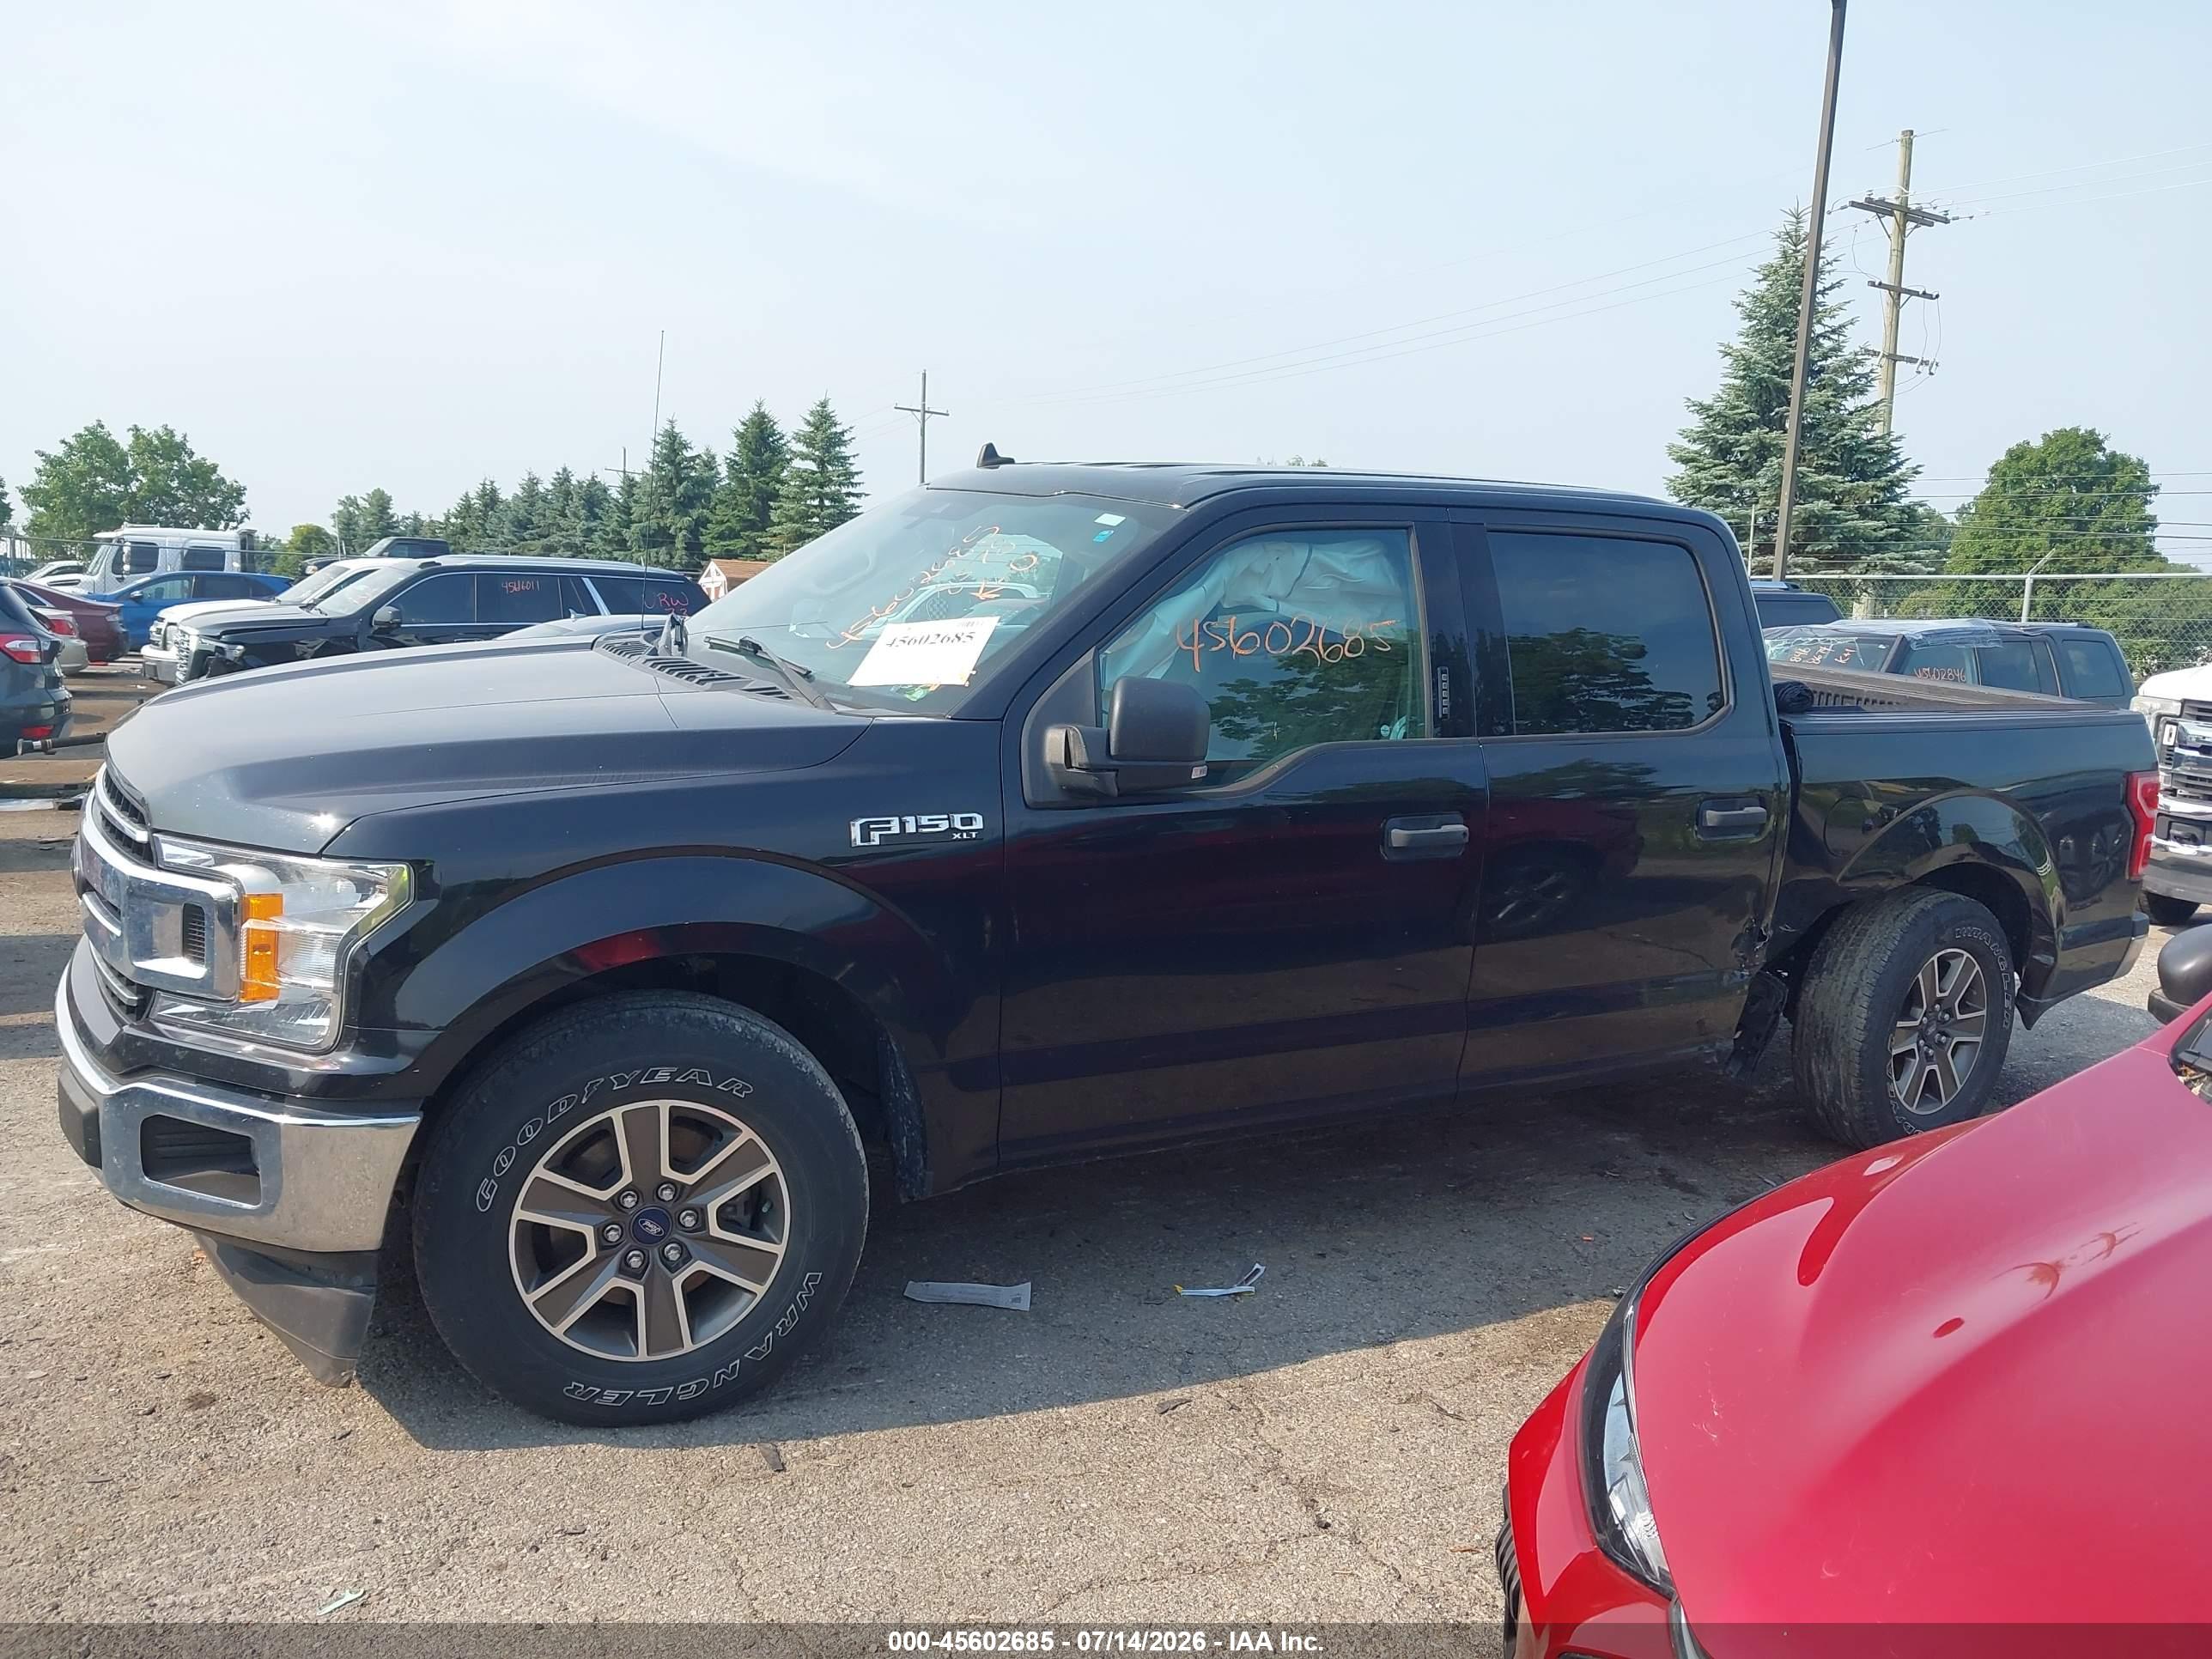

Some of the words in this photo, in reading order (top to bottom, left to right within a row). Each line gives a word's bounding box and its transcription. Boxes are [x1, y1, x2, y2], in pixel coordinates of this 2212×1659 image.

[885, 631, 976, 647] 45602685
[1176, 615, 1401, 673] 45602685
[951, 831, 980, 840] XLT
[475, 1066, 756, 1212] GOODYEAR
[562, 1270, 823, 1407] WRANGLER
